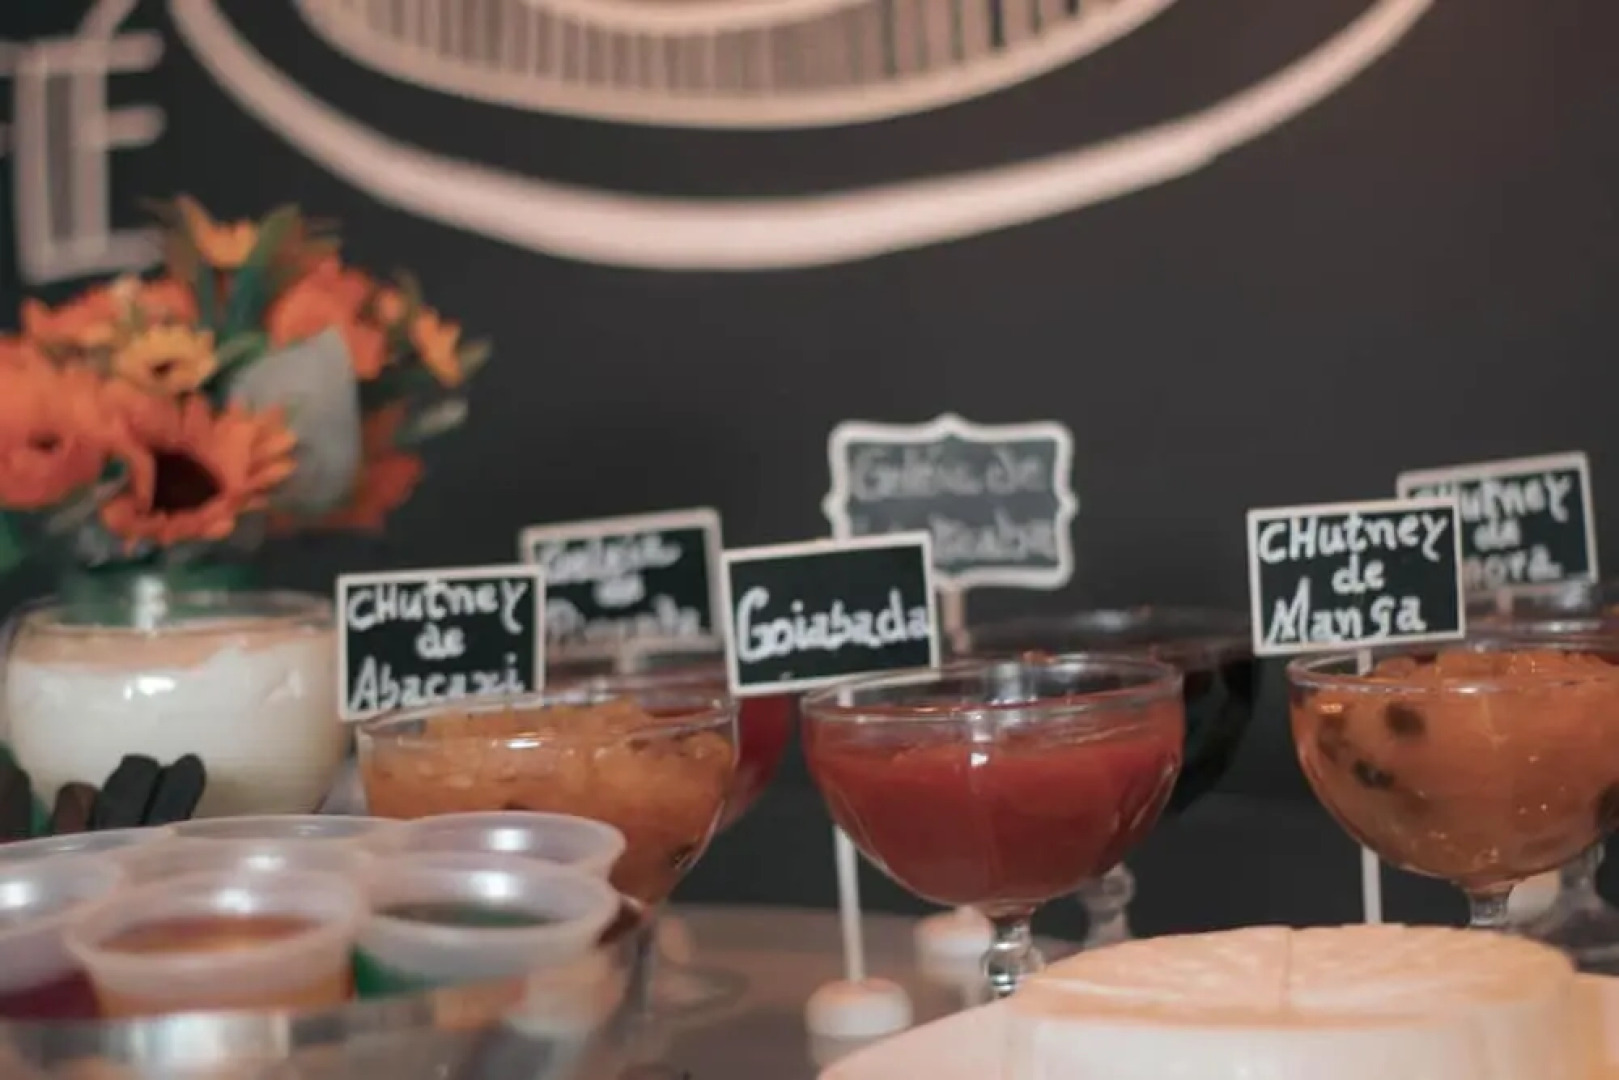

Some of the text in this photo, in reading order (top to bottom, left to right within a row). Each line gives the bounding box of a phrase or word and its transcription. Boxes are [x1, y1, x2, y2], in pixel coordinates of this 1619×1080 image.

[1408, 474, 1572, 524] utney
[1331, 556, 1385, 594] de
[737, 586, 931, 662] Goiabada
[1266, 577, 1427, 645] Manga
[415, 620, 466, 660] de
[350, 652, 525, 713] Abacaxi
